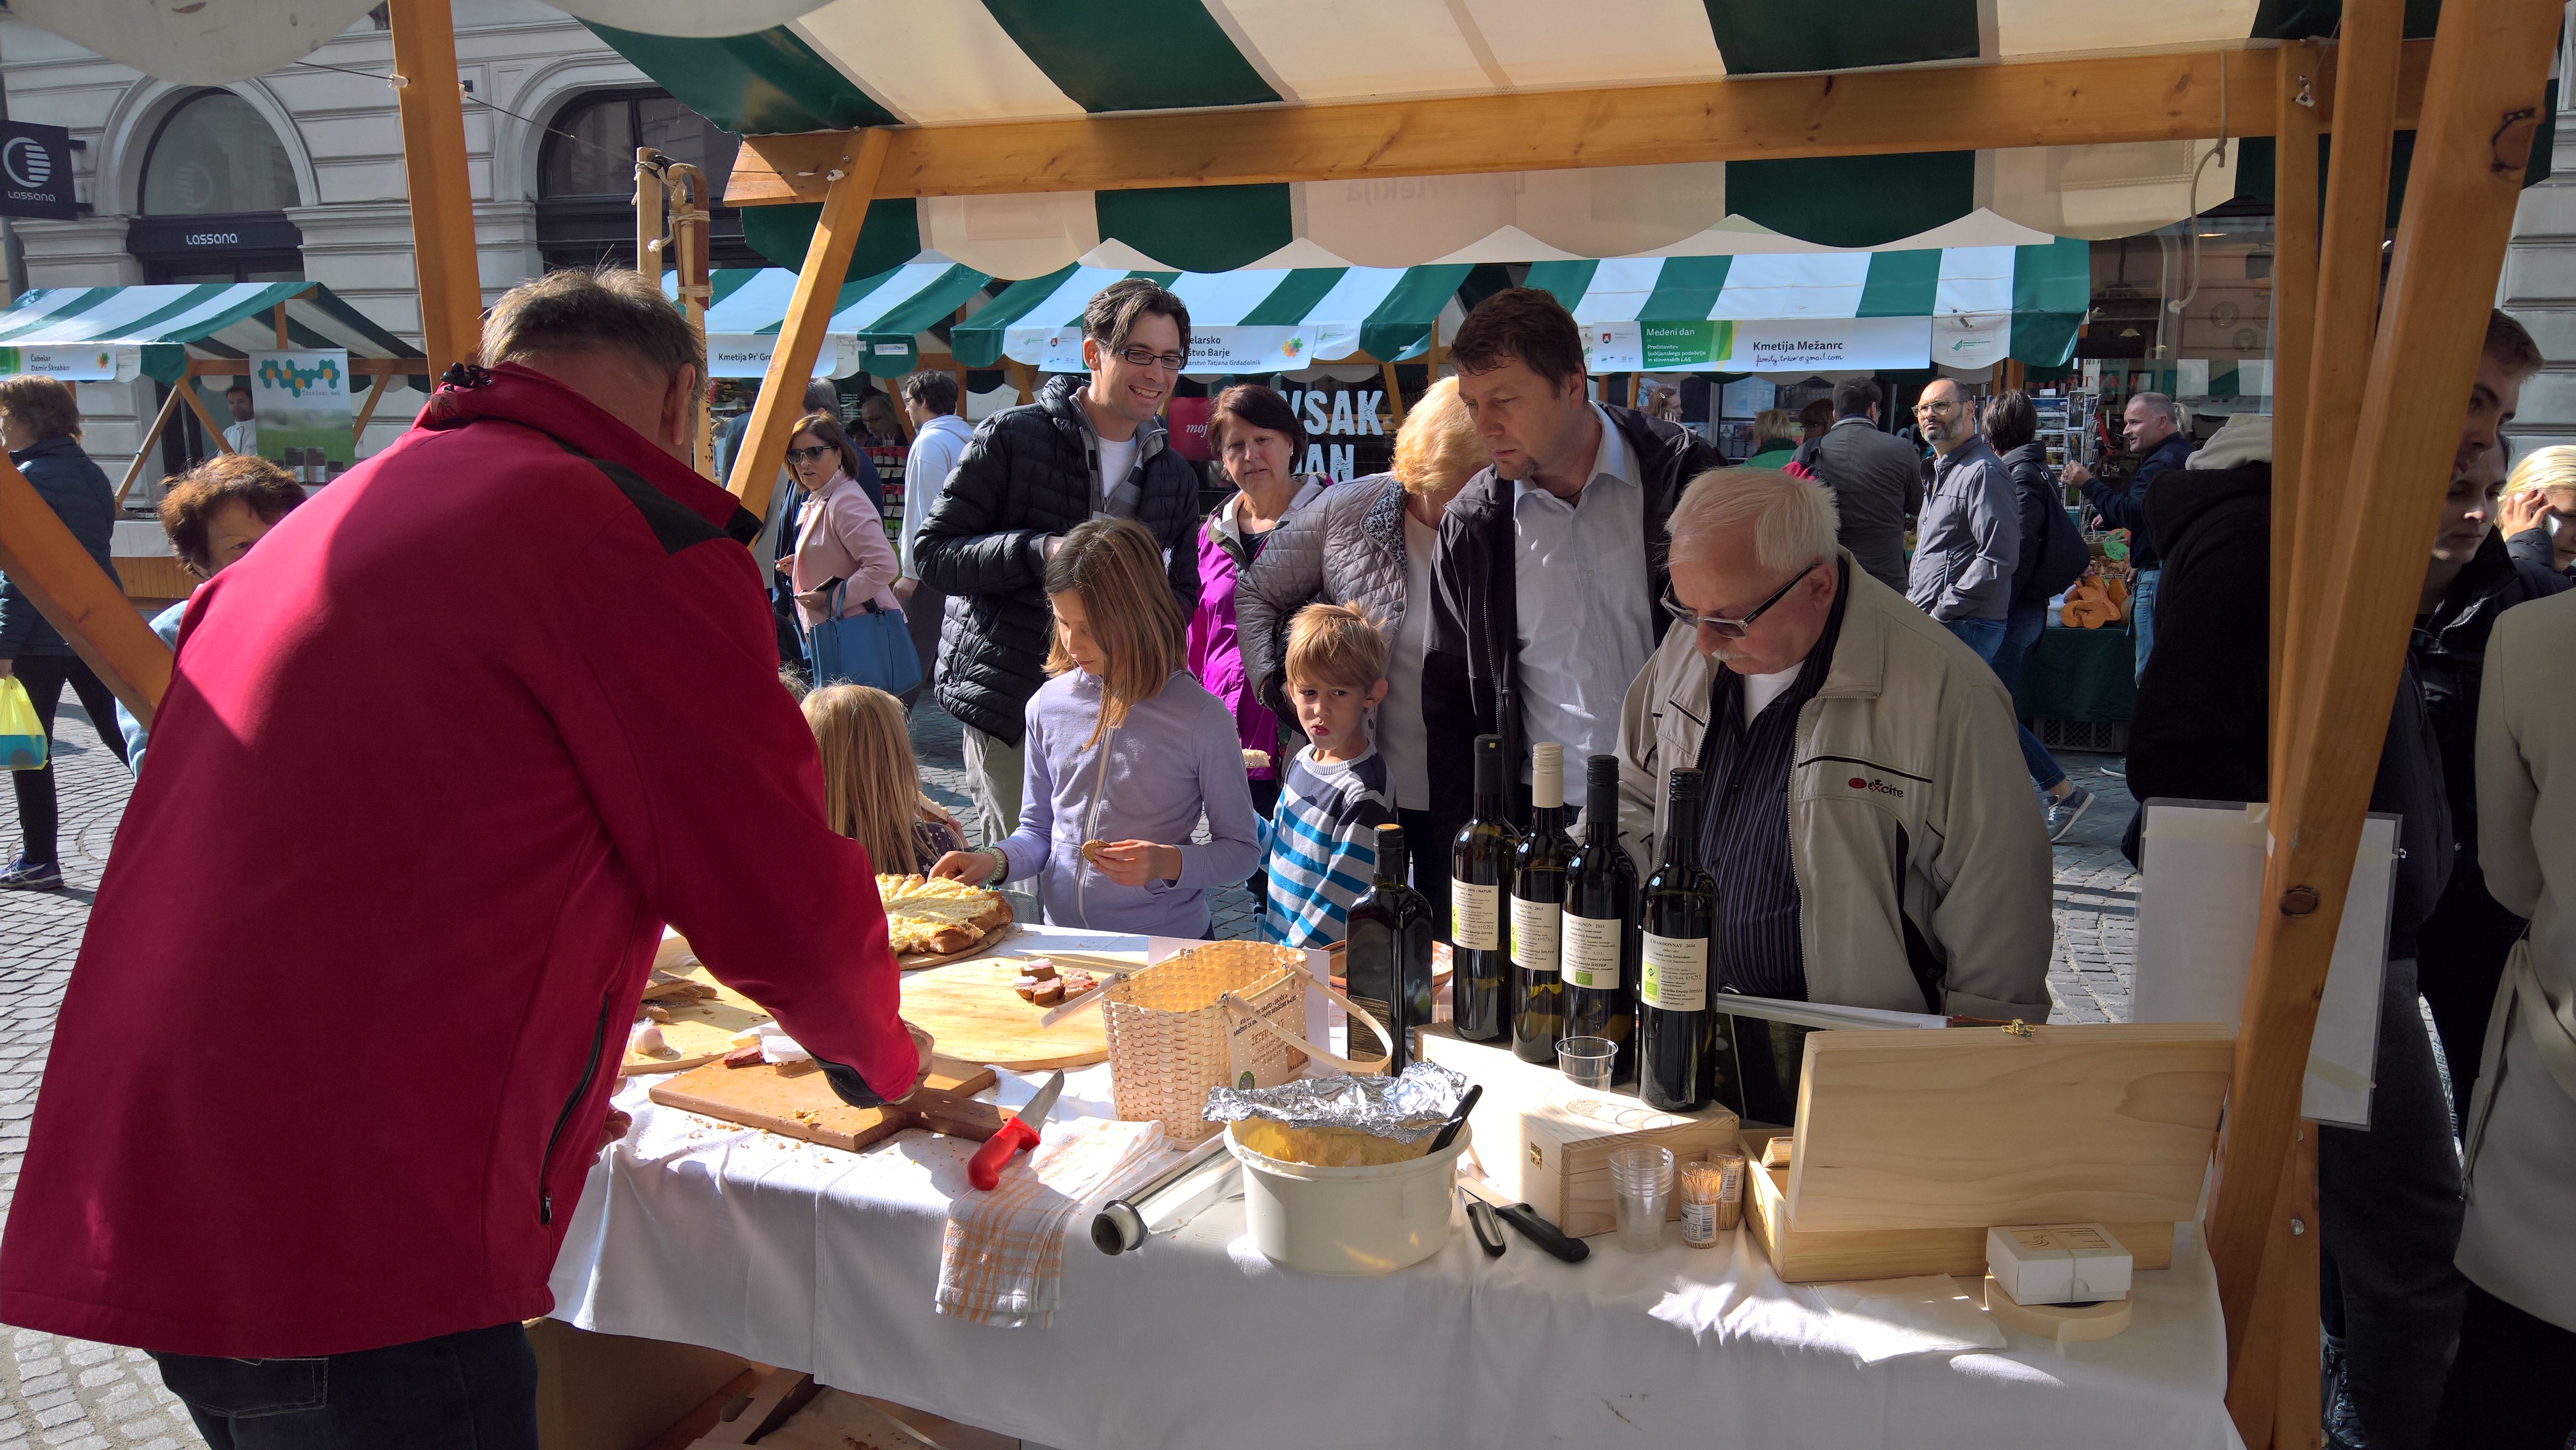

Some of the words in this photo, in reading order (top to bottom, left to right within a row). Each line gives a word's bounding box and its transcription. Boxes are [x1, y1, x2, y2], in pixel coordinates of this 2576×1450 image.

[1190, 336, 1221, 344] elarsko
[1753, 341, 1795, 352] Kmetija
[1798, 340, 1843, 350] Mežanrc
[31, 353, 51, 362] Čebelar
[718, 353, 747, 362] Kmetija
[1188, 348, 1206, 356] štvo
[1208, 348, 1230, 358] Barje
[1295, 443, 1354, 483] AN
[1569, 919, 1592, 927] SAUVIGNON
[1650, 939, 1682, 948] CHARDONNAY
[1252, 1030, 1268, 1046] ŽETEV
